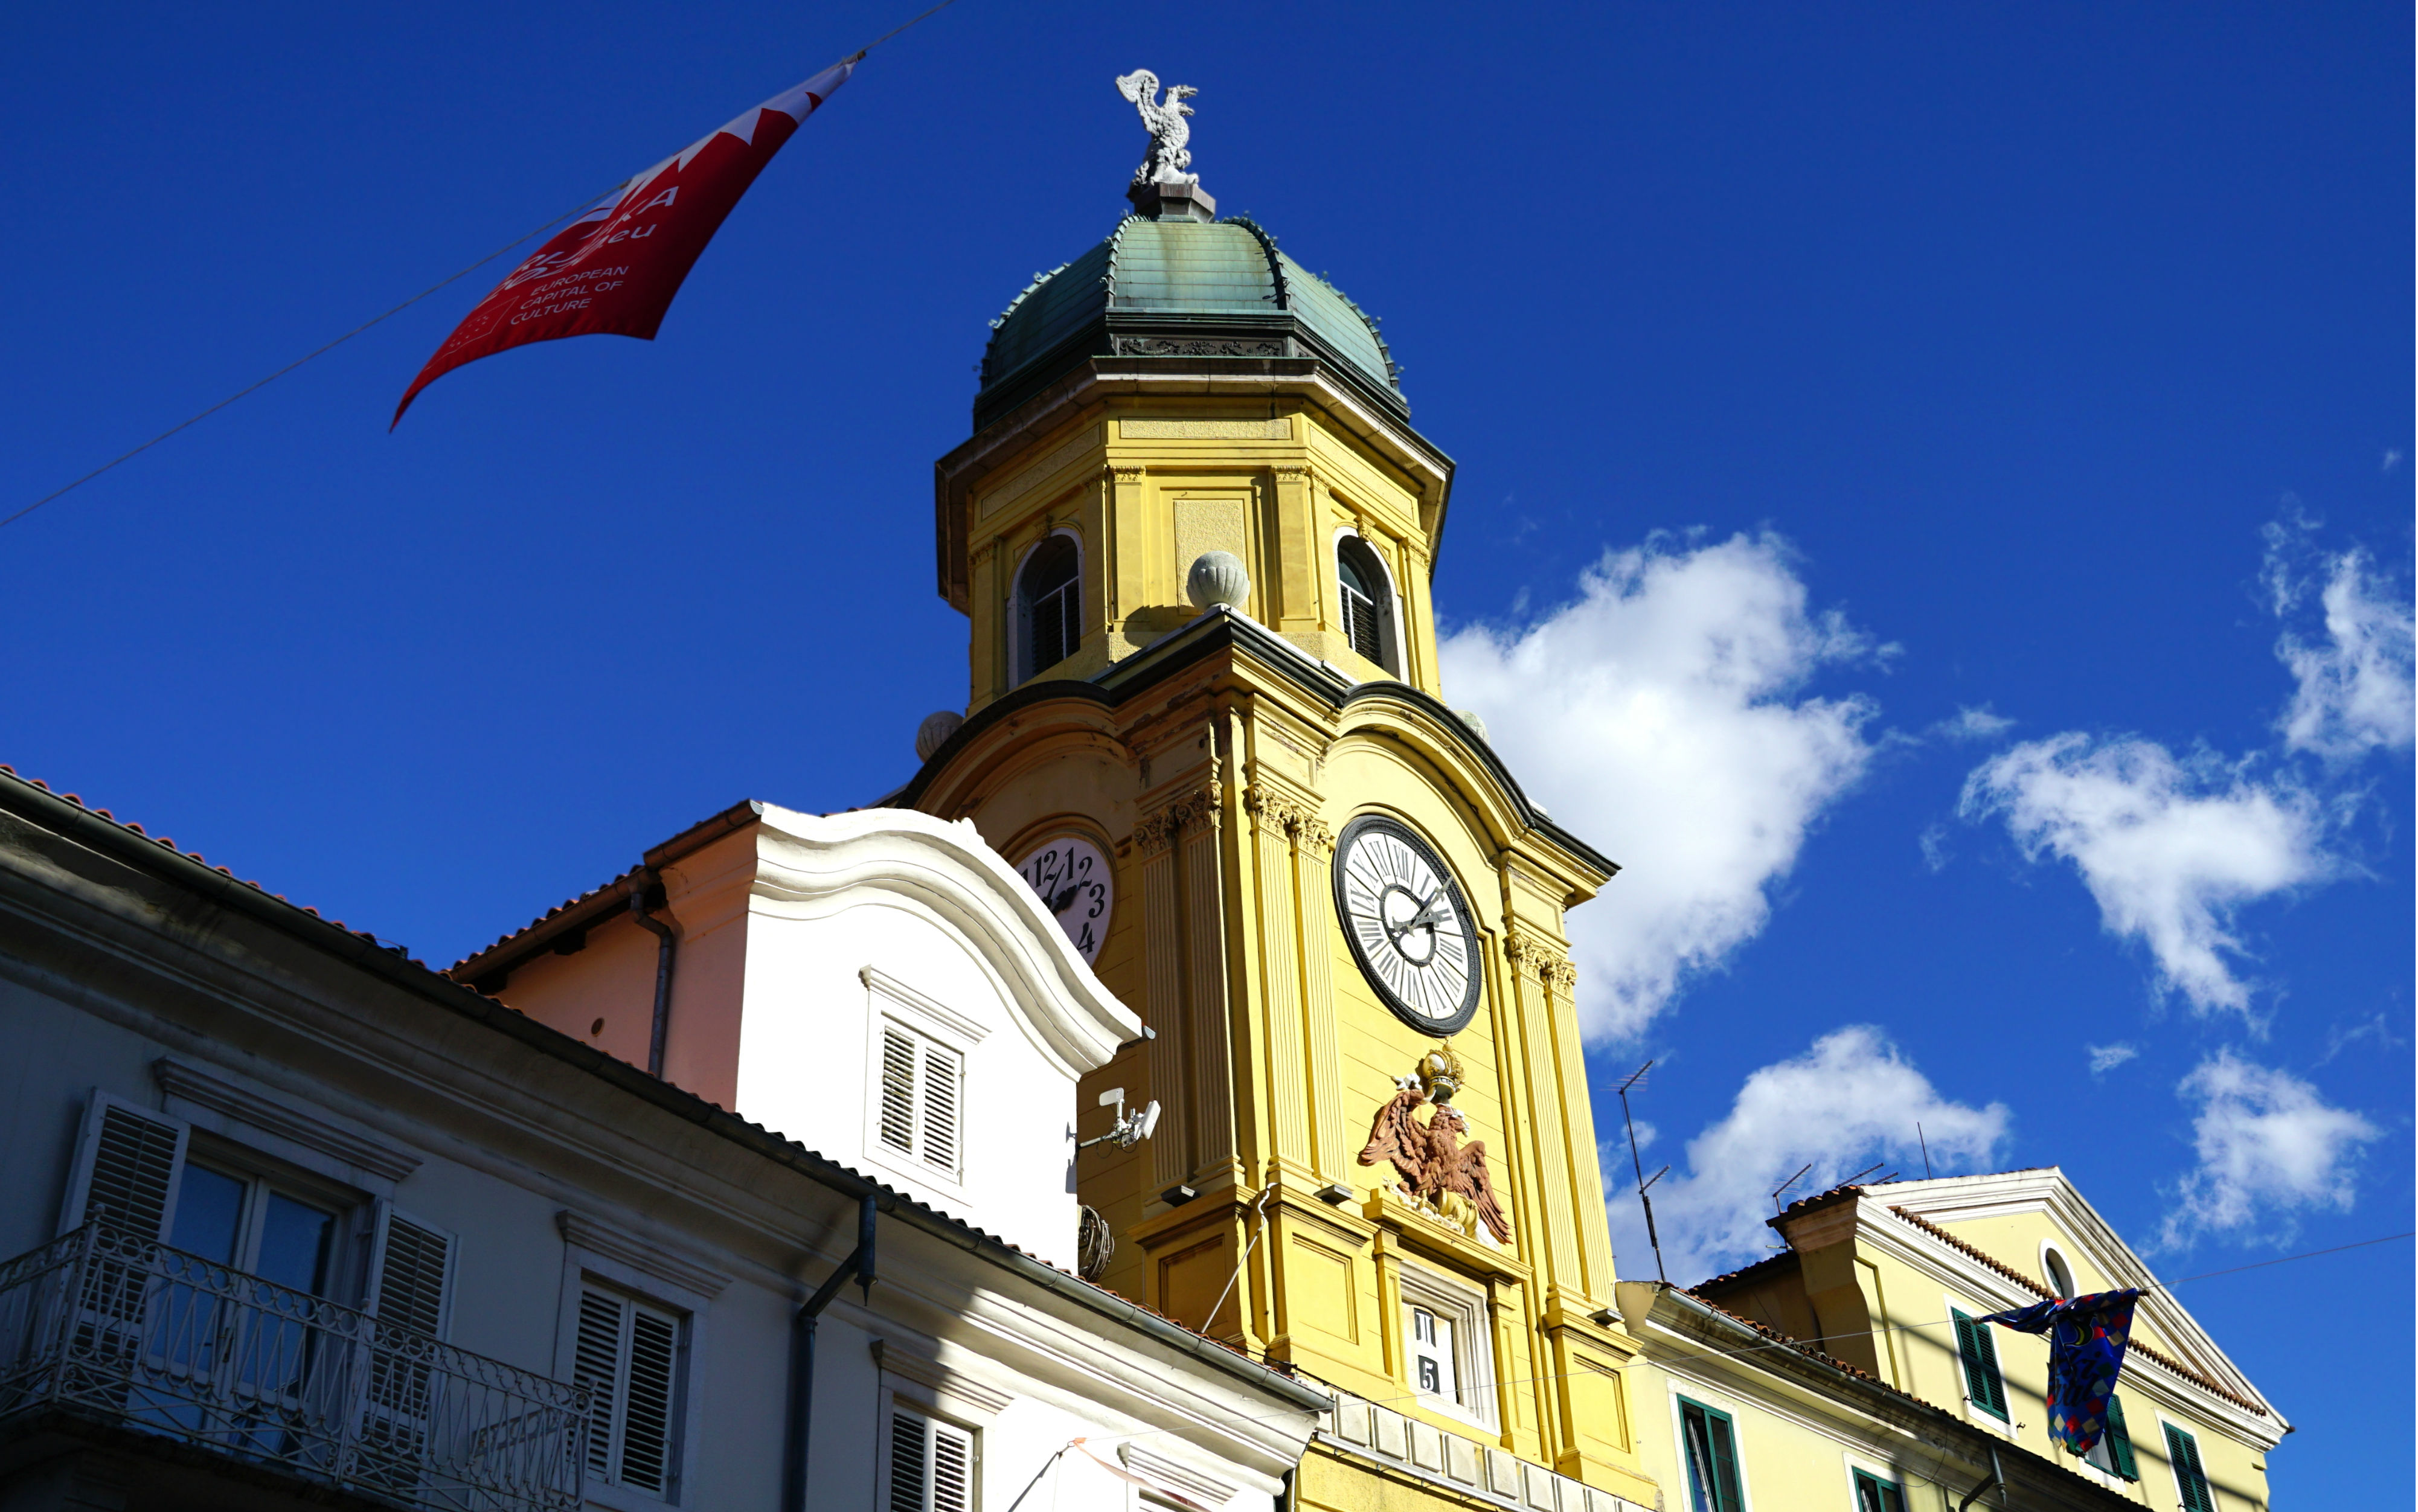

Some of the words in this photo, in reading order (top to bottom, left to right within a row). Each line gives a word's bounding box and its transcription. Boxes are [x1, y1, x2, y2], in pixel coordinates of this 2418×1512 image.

[520, 284, 589, 309] CAPITAL
[594, 281, 624, 292] OF
[530, 266, 629, 296] EUROPEAN
[510, 298, 592, 325] CULTURE
[1034, 850, 1057, 888] 12
[1065, 847, 1074, 881] 1
[1079, 856, 1092, 891] 2
[1089, 883, 1105, 918] 3
[1077, 922, 1095, 954] 4
[1423, 1361, 1434, 1391] 5
